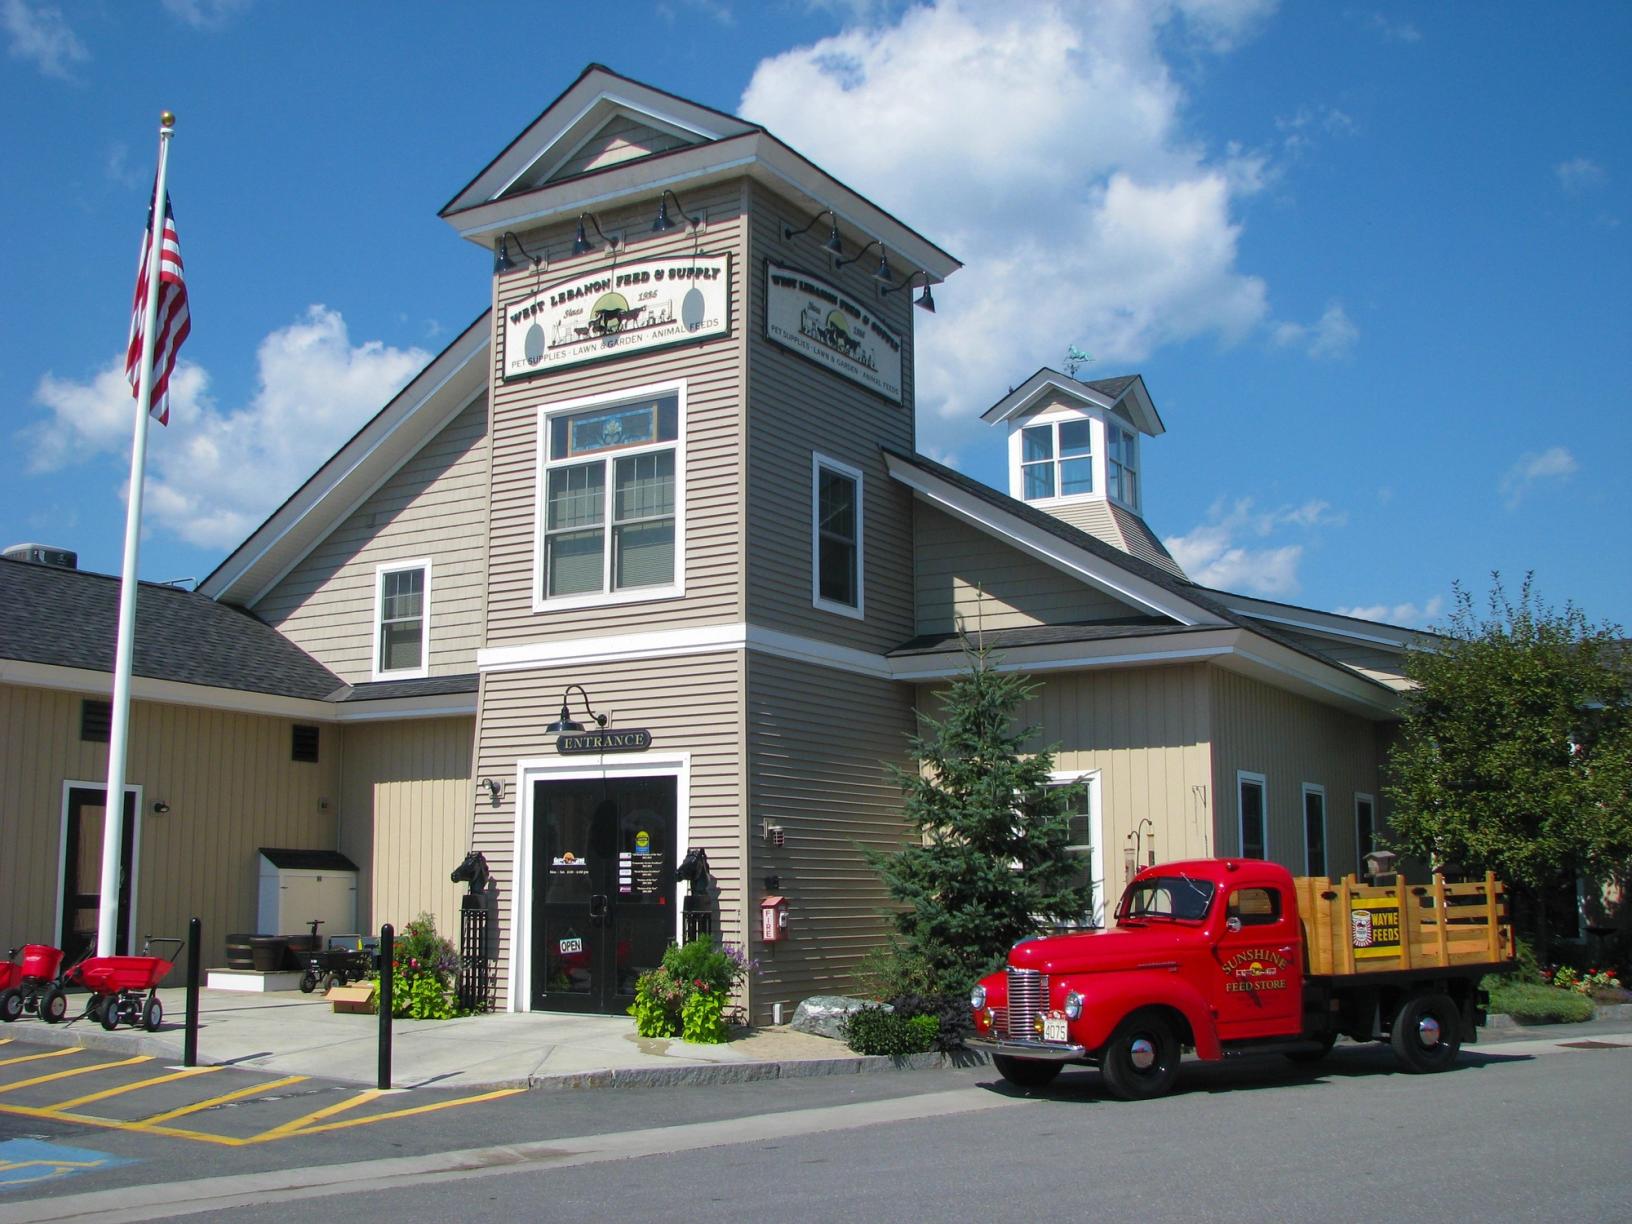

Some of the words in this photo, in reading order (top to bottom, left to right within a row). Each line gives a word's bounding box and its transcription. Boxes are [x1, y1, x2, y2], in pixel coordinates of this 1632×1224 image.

[510, 300, 545, 325] WEST
[550, 278, 611, 307] LEBANON
[616, 271, 651, 288] FEED
[668, 267, 721, 281] SUPPLY
[511, 358, 526, 369] PET
[528, 350, 567, 366] SUPPLIES
[573, 343, 597, 356] LAWN
[607, 334, 643, 349] GARDEN
[652, 326, 686, 339] ANIMAL
[689, 318, 719, 331] FEEDS
[564, 733, 644, 749] ENTRANCE
[1371, 912, 1398, 926] WAYNE
[1373, 928, 1399, 941] FEEDS
[561, 940, 581, 952] OPEN
[1222, 949, 1288, 975] SUNSHINE
[1226, 981, 1253, 992] FEED
[1254, 979, 1287, 991] STORE
[1045, 1025, 1066, 1040] 4075
